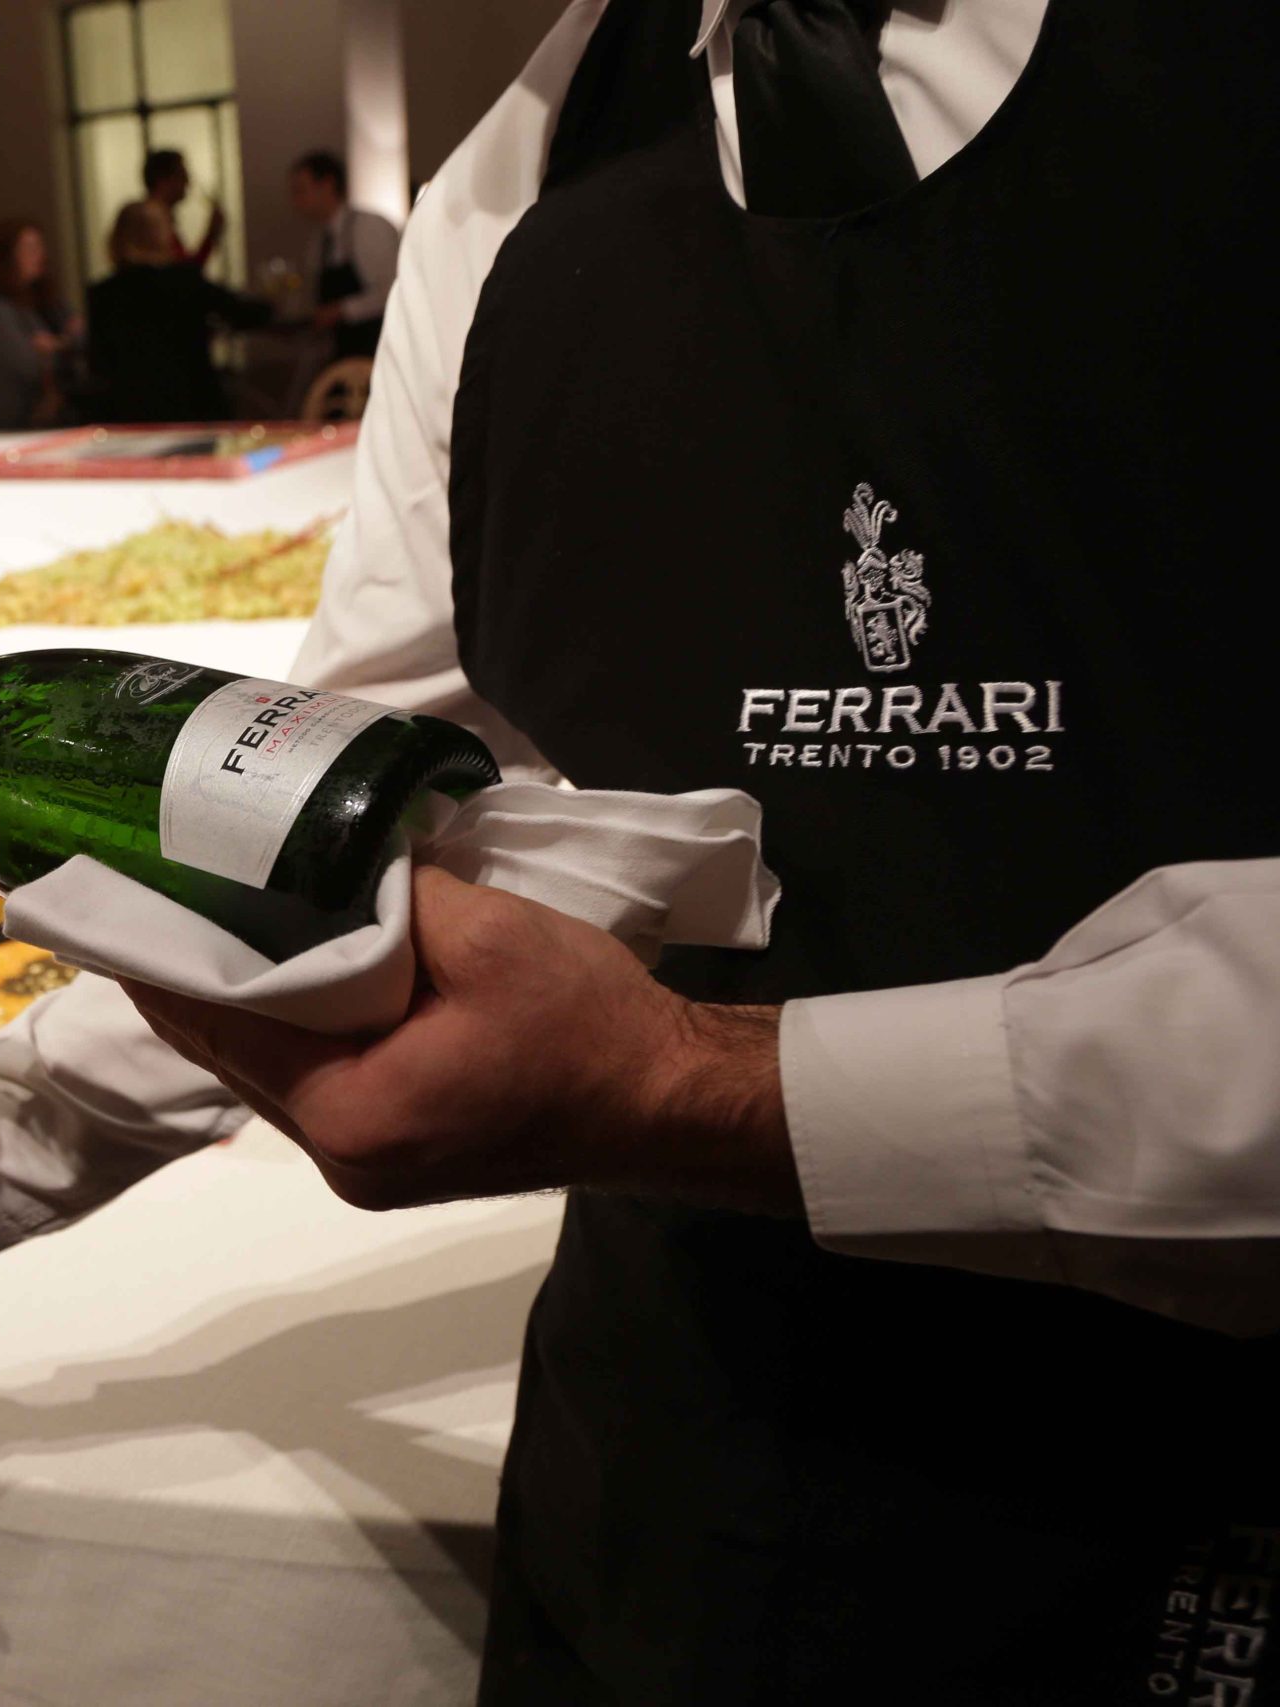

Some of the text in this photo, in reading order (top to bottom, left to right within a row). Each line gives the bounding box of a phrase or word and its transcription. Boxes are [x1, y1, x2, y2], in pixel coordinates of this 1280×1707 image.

[221, 690, 327, 775] FERRA
[266, 697, 341, 753] MAXIMU
[736, 680, 1065, 734] FERRARI
[743, 743, 1054, 771] TRENTO 1902
